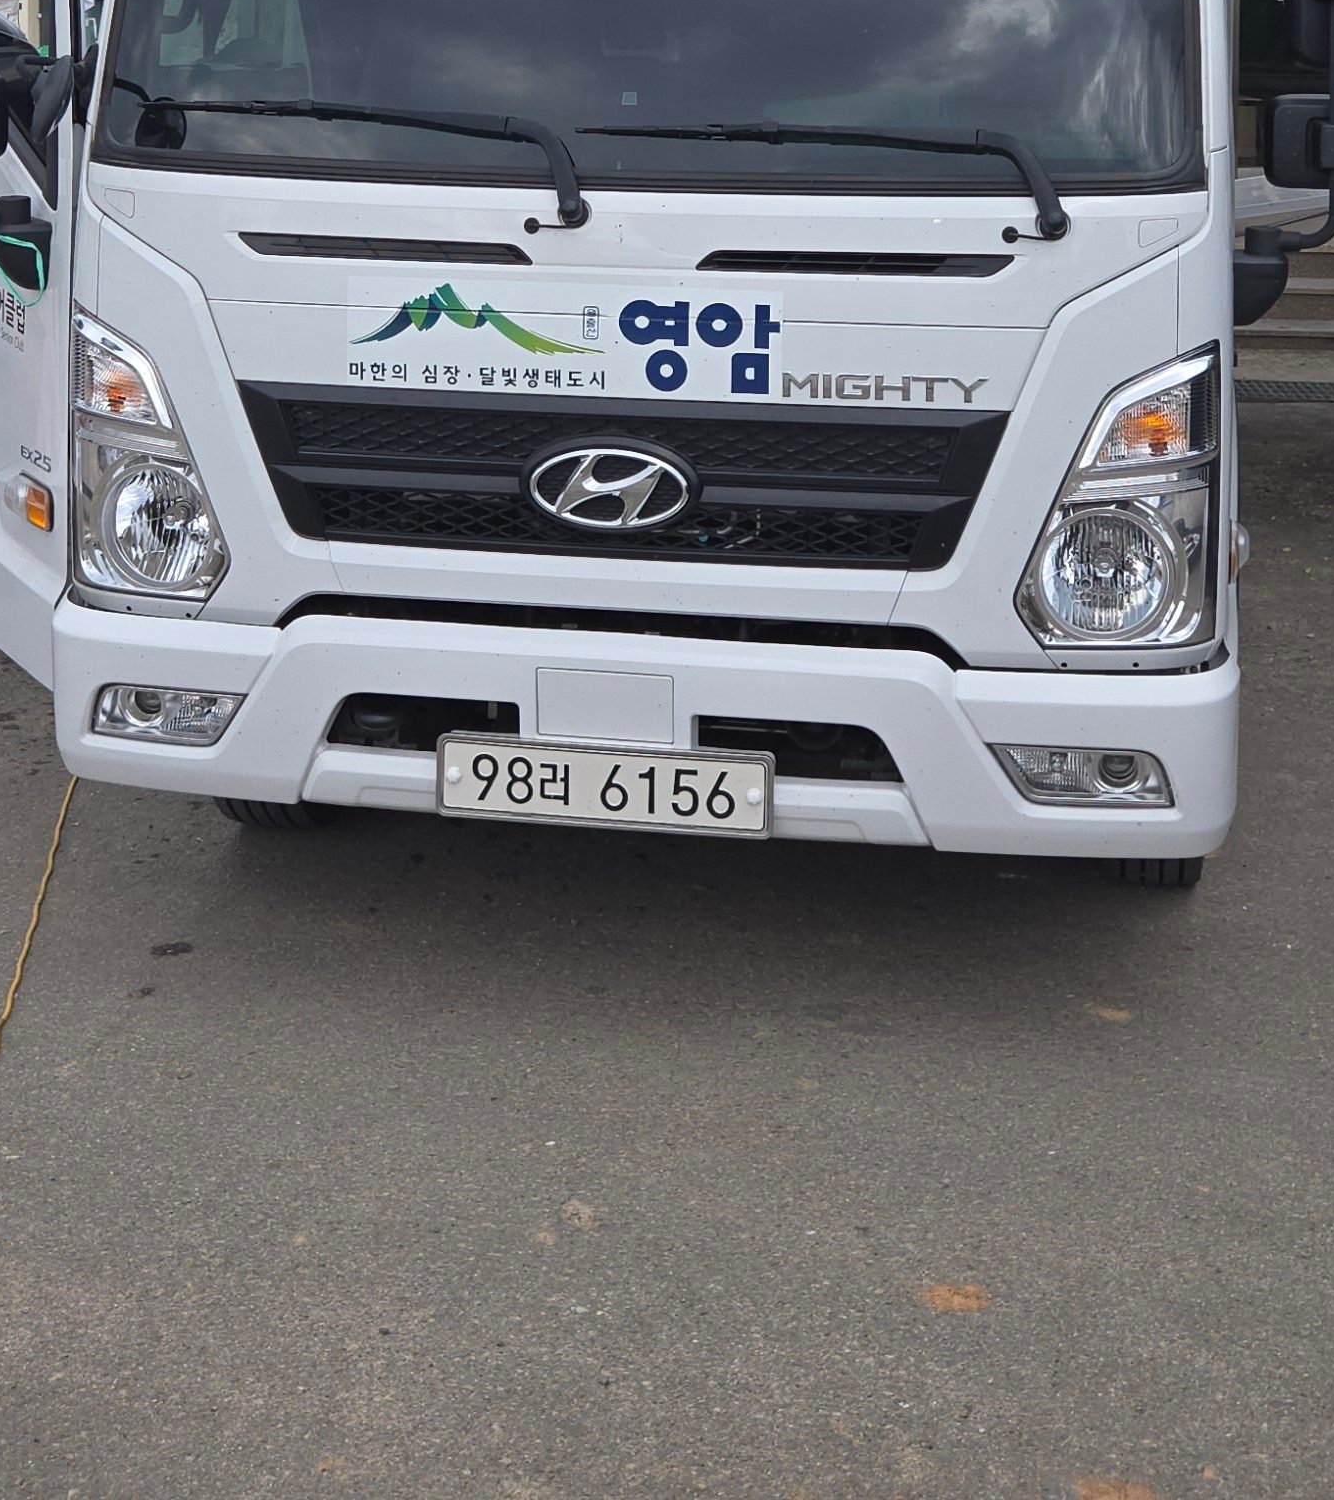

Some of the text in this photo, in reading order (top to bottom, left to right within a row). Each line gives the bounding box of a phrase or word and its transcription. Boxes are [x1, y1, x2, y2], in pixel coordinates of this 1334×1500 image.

[348, 361, 408, 382] 마한의
[619, 299, 781, 395] 영암
[782, 371, 990, 403] MIGHTY
[471, 753, 736, 820] 98러 6156
